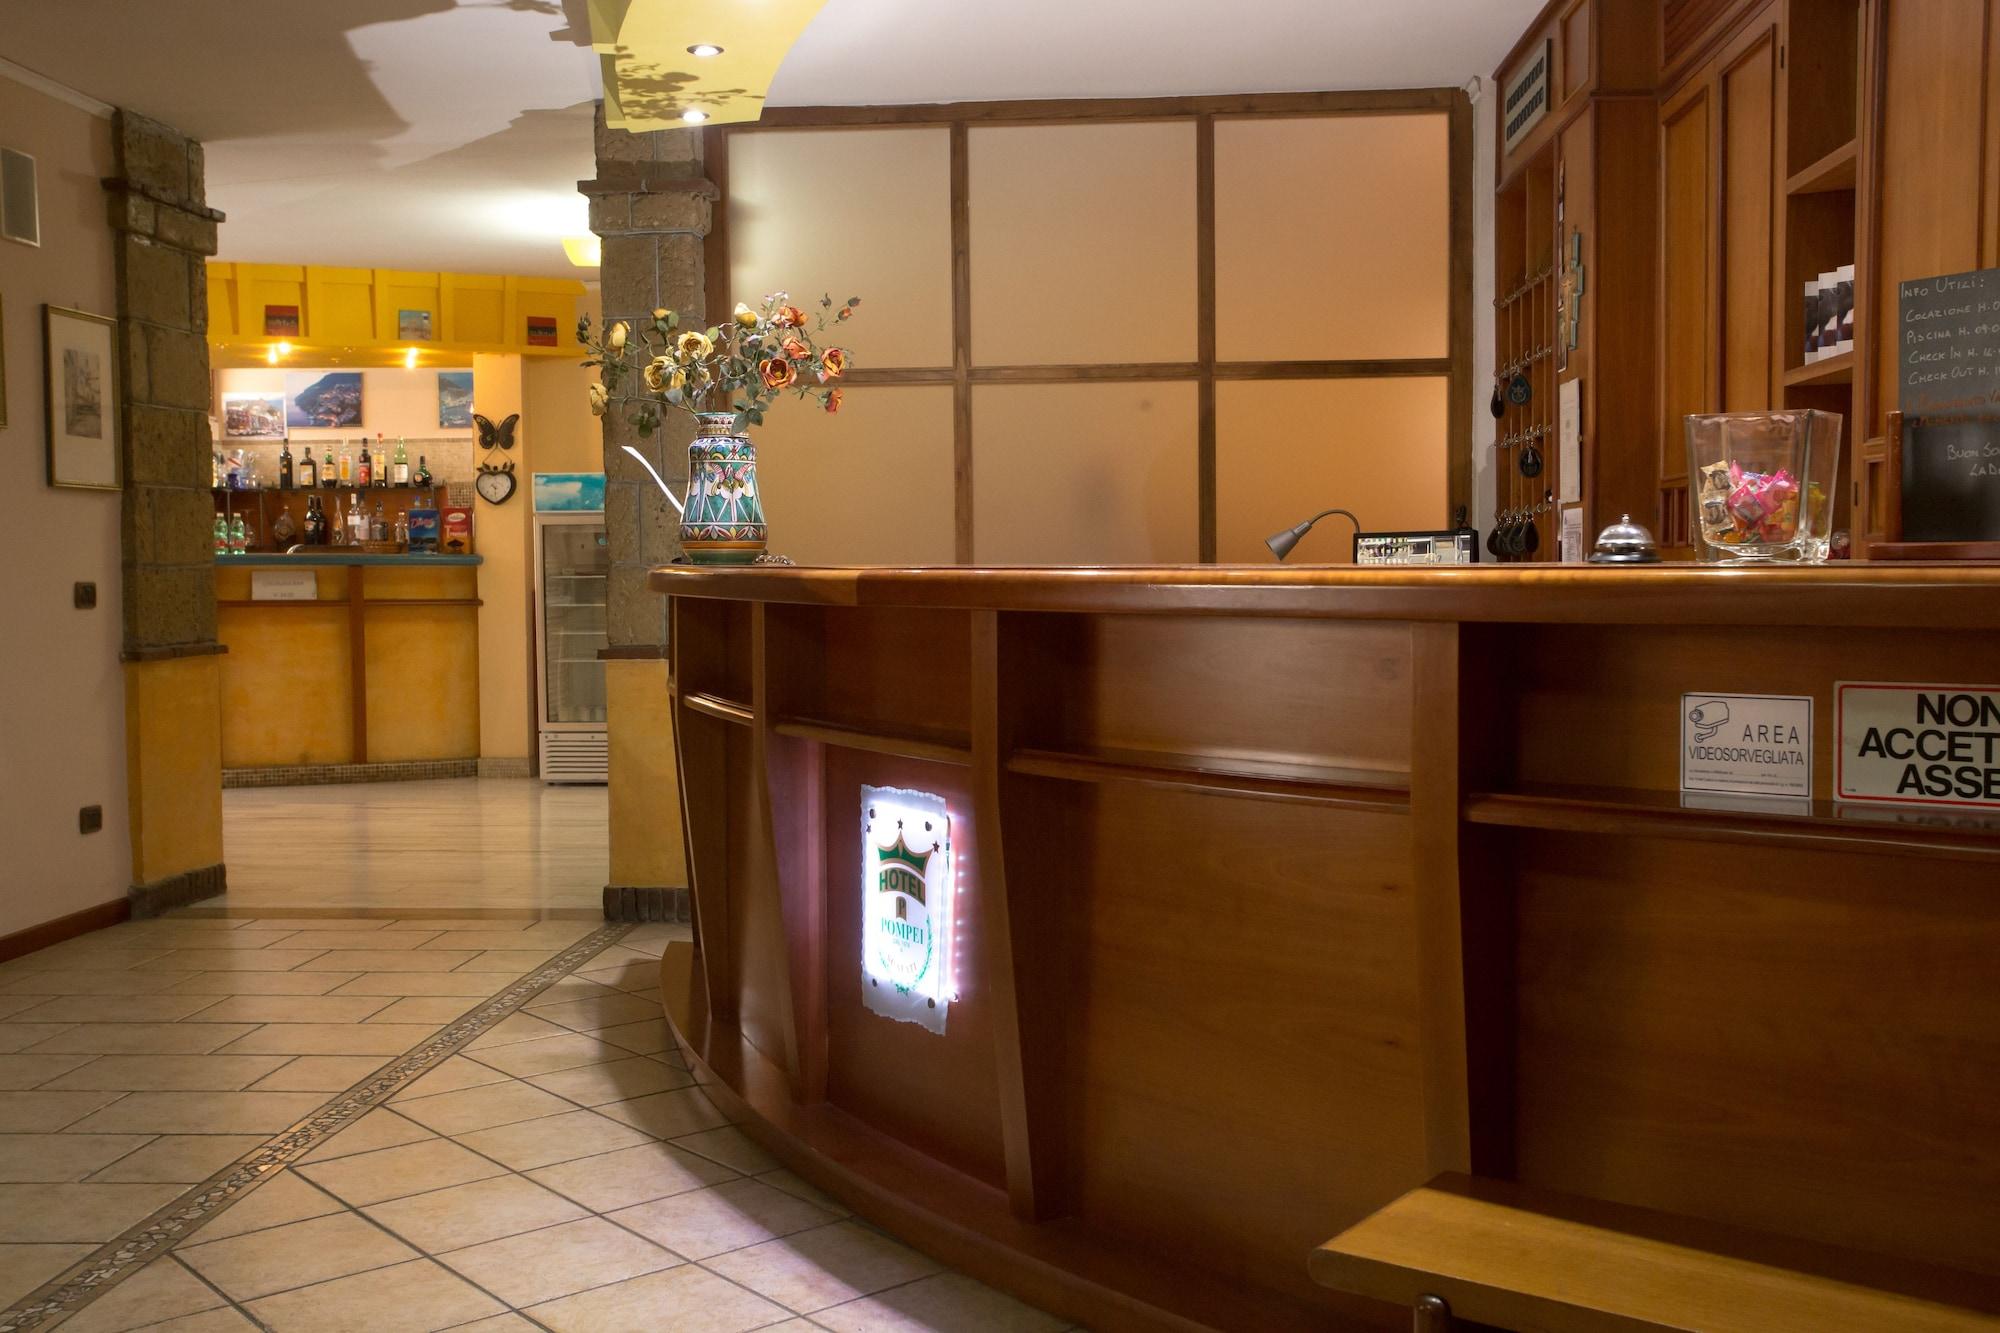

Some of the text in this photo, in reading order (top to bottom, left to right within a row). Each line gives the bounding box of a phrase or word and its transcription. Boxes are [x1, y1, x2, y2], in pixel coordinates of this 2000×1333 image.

[1907, 330, 1952, 344] PISCINA
[1951, 366, 1974, 378] OUT
[1917, 693, 2000, 727] NON
[1742, 724, 1800, 744] AREA
[1689, 746, 1804, 766] VIDEOSORVEGLIATA
[1896, 764, 2000, 799] ASSE
[879, 868, 925, 903] HOTEL
[881, 917, 924, 945] POMPEI
